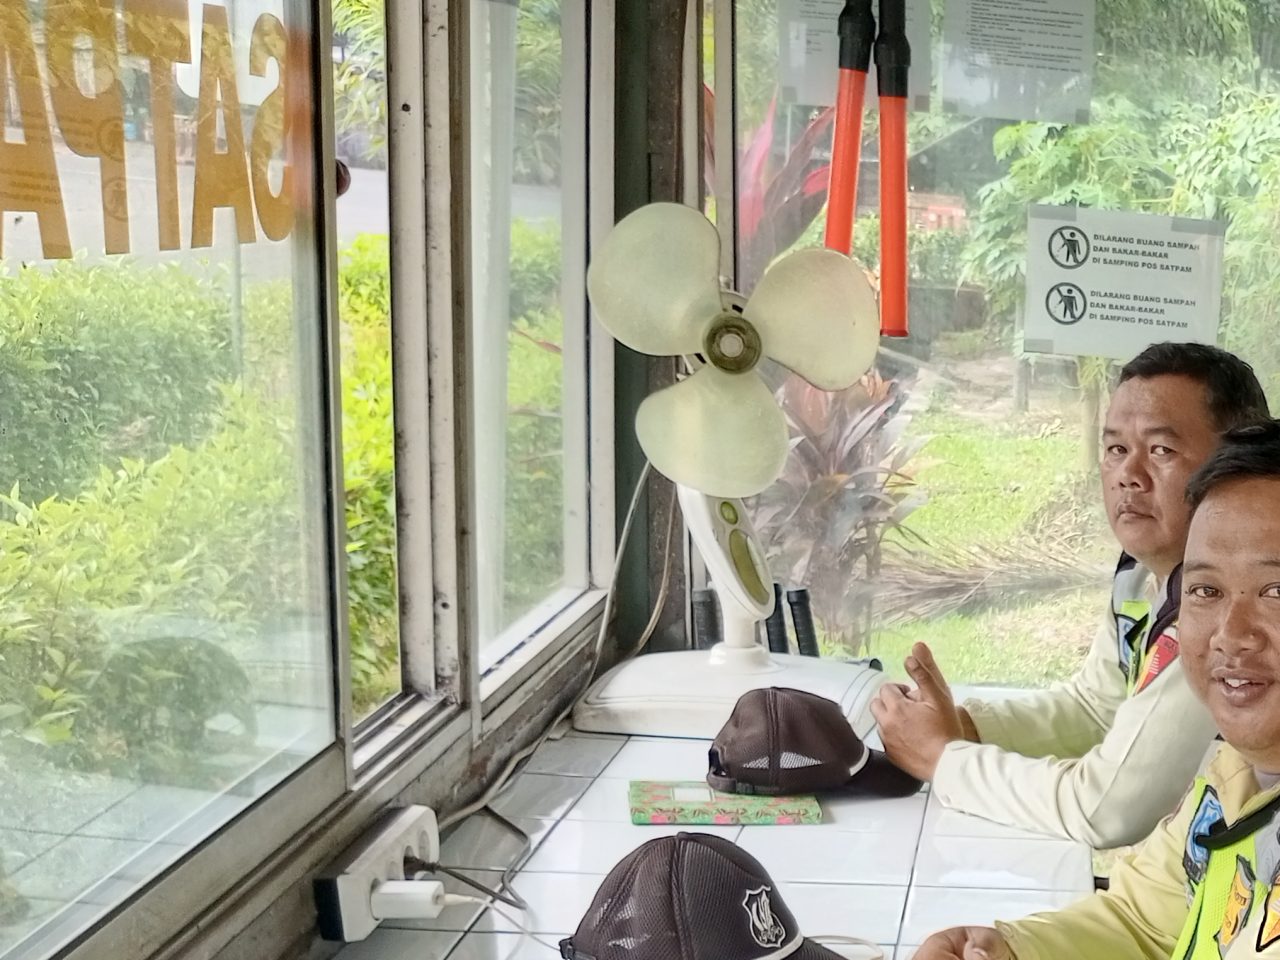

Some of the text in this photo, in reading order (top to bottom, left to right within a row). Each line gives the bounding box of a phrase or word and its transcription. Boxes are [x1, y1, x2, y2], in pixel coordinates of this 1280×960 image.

[1093, 234, 1200, 251] DILARANG BUANG SAMPAH
[1092, 245, 1169, 259] DAN BAKAR-BAKAR
[1103, 258, 1139, 268] SAMPING
[1141, 262, 1158, 270] POS
[1159, 264, 1192, 273] SATPAM
[1090, 290, 1196, 307] DILARANG BUANG SAMPAH
[1089, 301, 1165, 315] DAN BAKAR-BAKAR
[1099, 314, 1136, 324] SAMPING
[1138, 317, 1154, 326] POS
[1156, 319, 1188, 329] SATPAM
